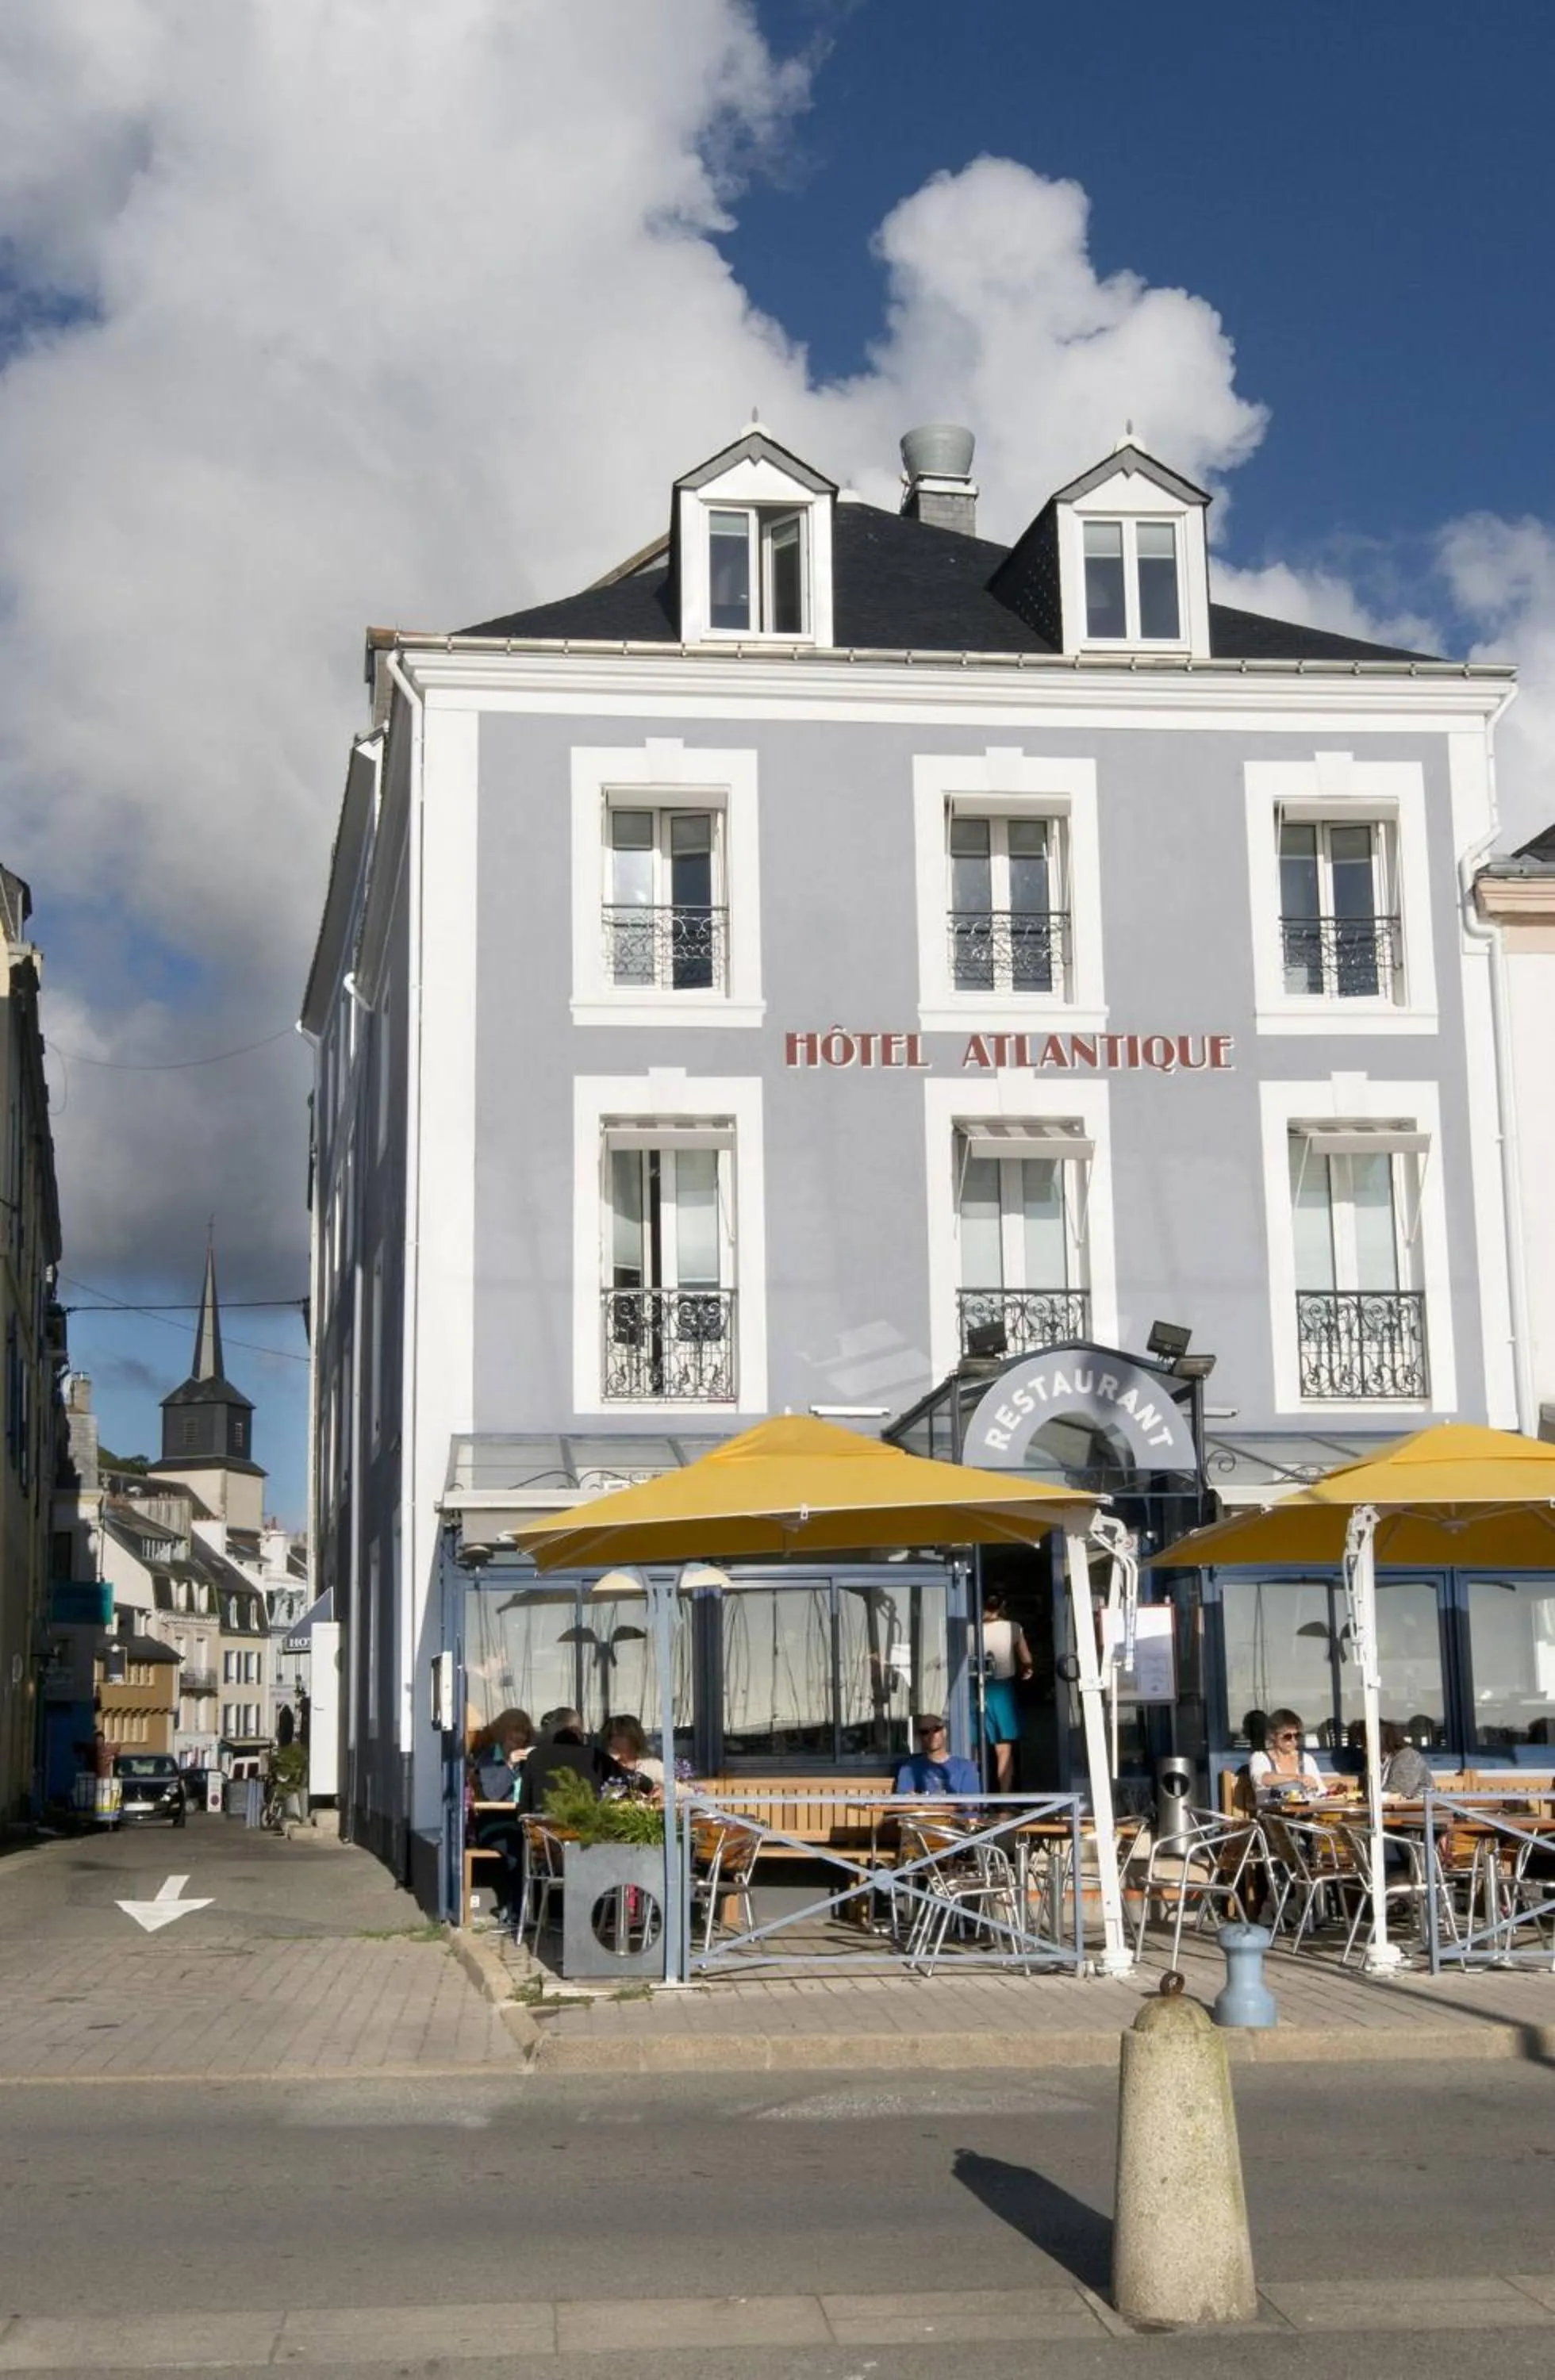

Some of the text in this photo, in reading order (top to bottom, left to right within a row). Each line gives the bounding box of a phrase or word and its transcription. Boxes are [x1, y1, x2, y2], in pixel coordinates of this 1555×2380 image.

[785, 1024, 1235, 1075] HÔTEL ATLANTIQUE
[984, 1368, 1175, 1451] RESTAURANT
